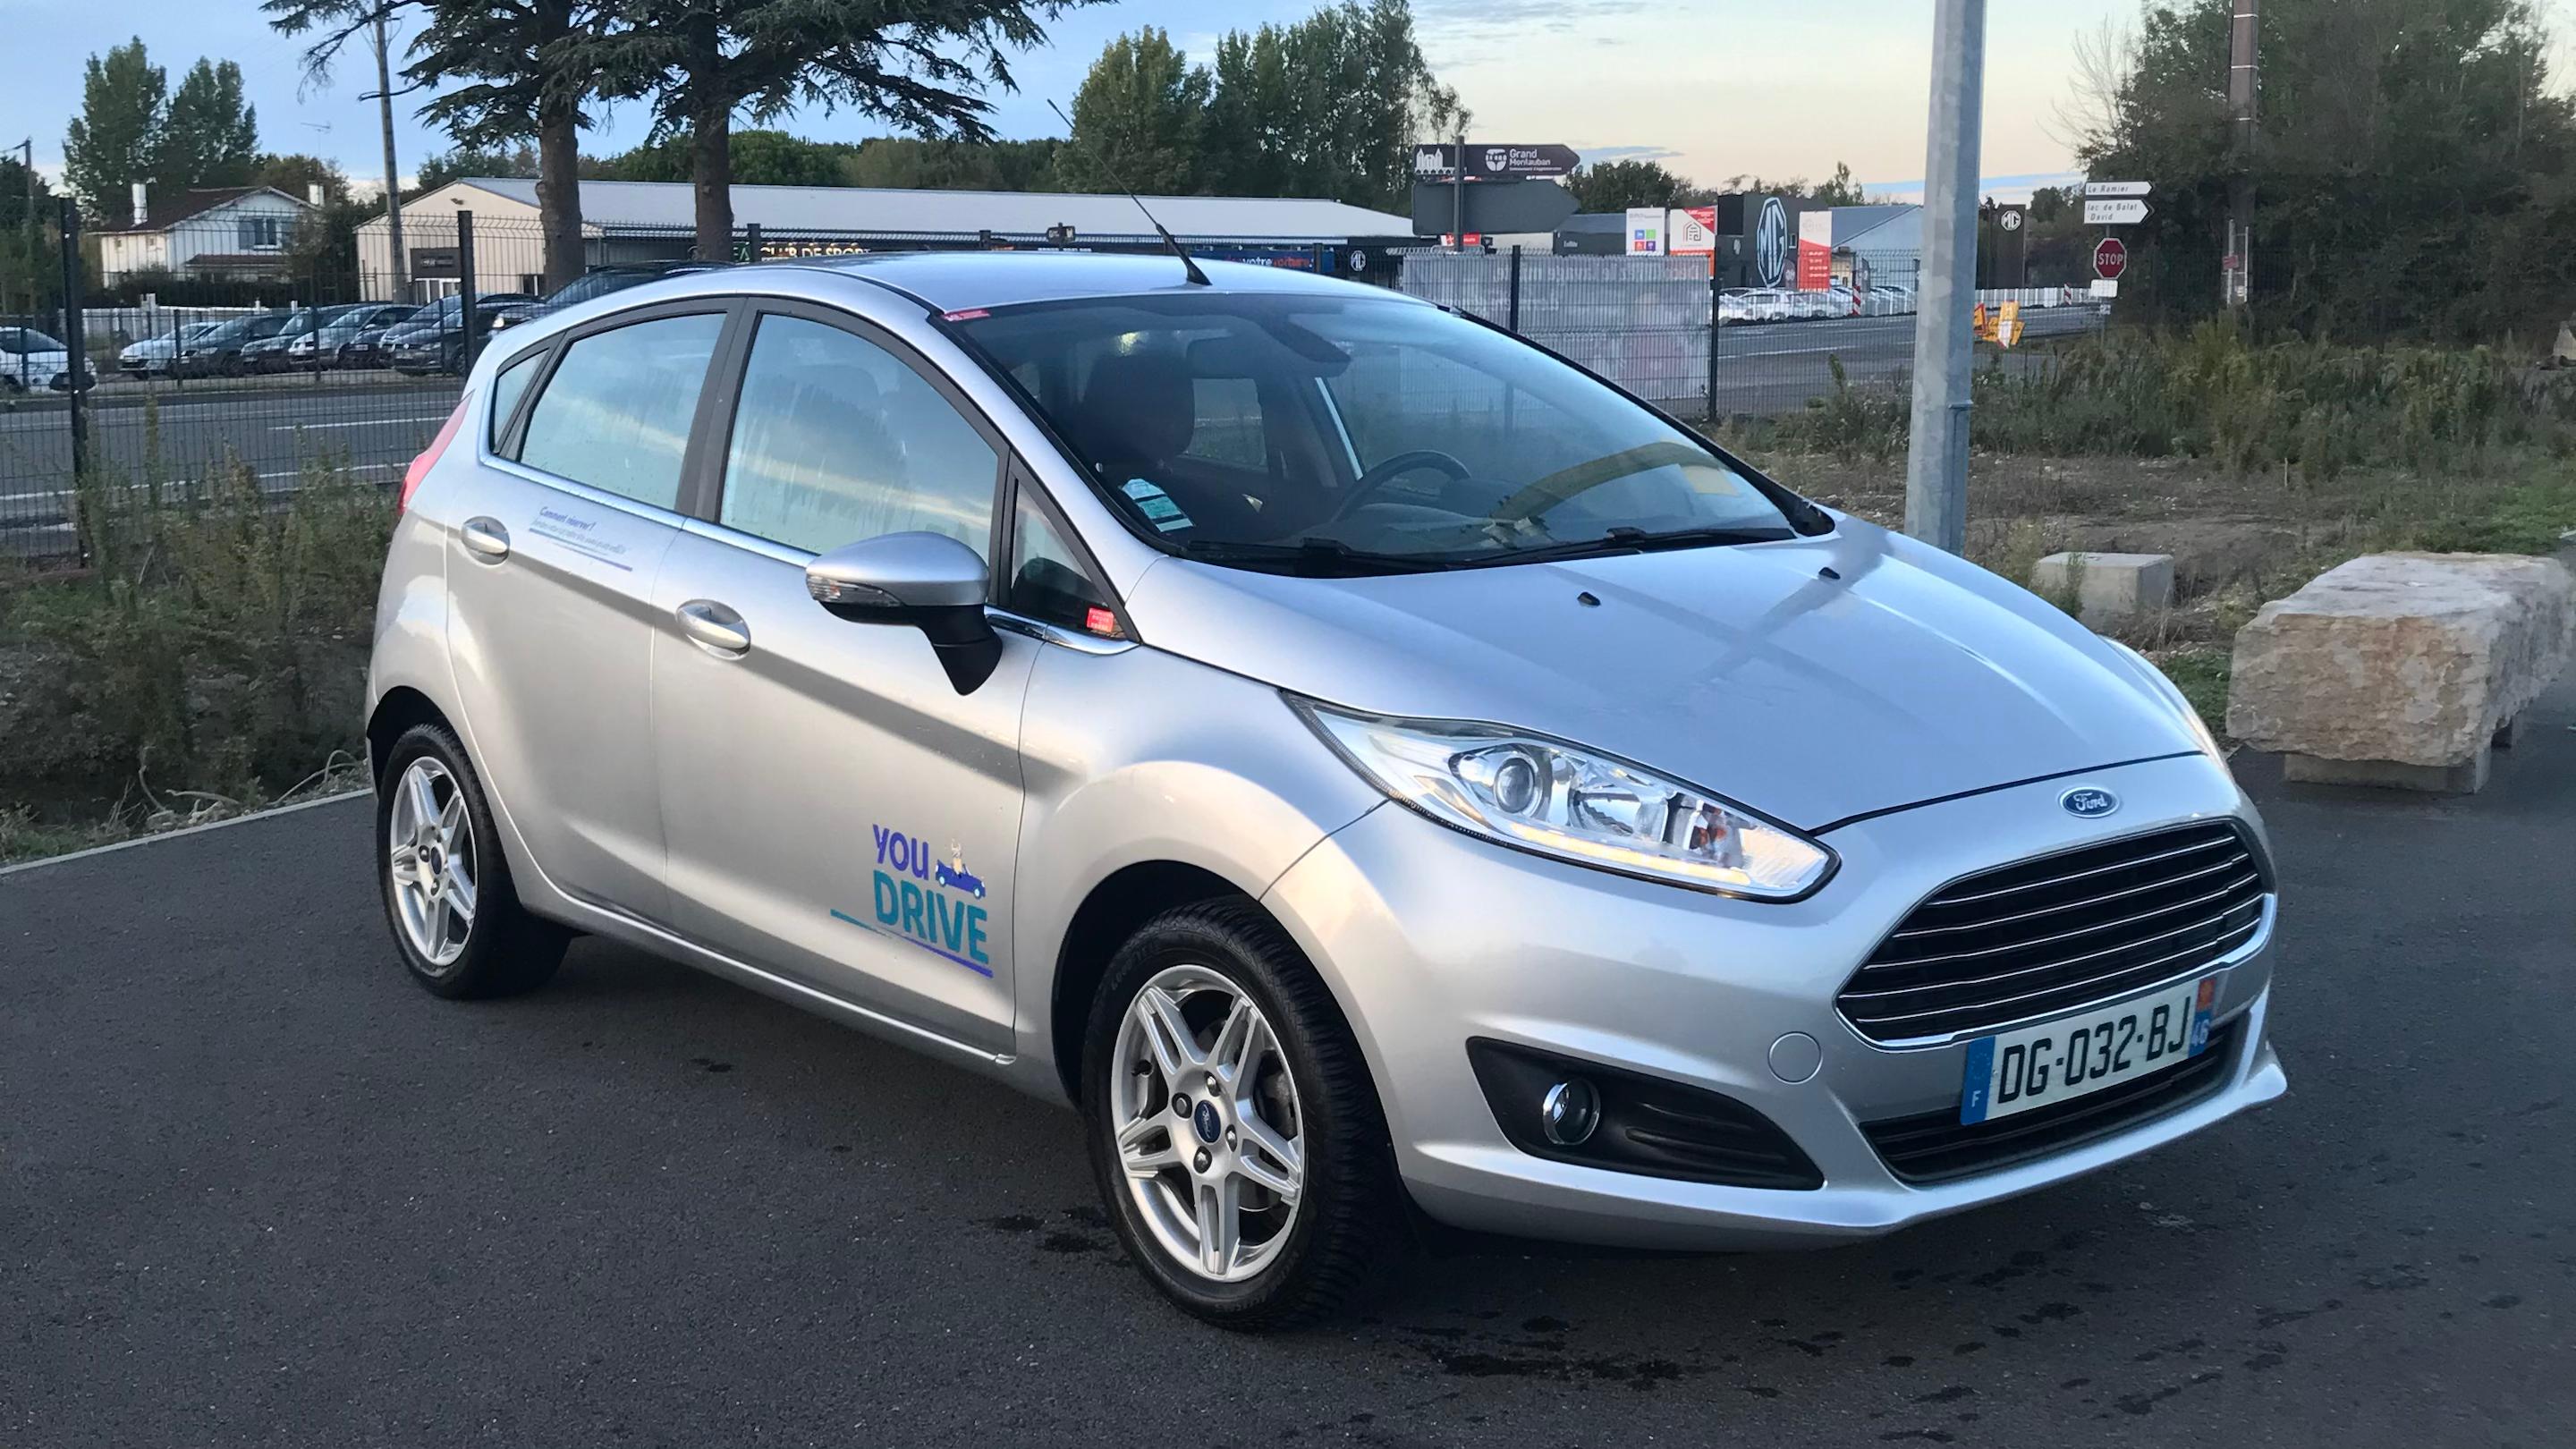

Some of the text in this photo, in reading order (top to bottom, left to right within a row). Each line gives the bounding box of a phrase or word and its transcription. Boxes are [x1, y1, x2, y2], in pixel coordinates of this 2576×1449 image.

[1509, 148, 1538, 159] Grand
[2100, 184, 2129, 193] Ramier
[2003, 212, 2020, 229] MG
[2090, 213, 2114, 221] David
[1759, 203, 1785, 281] MG
[2097, 253, 2123, 266] STOP
[2073, 792, 2108, 811] Ford
[873, 869, 989, 965] DRIVE
[1970, 1089, 1982, 1108] F
